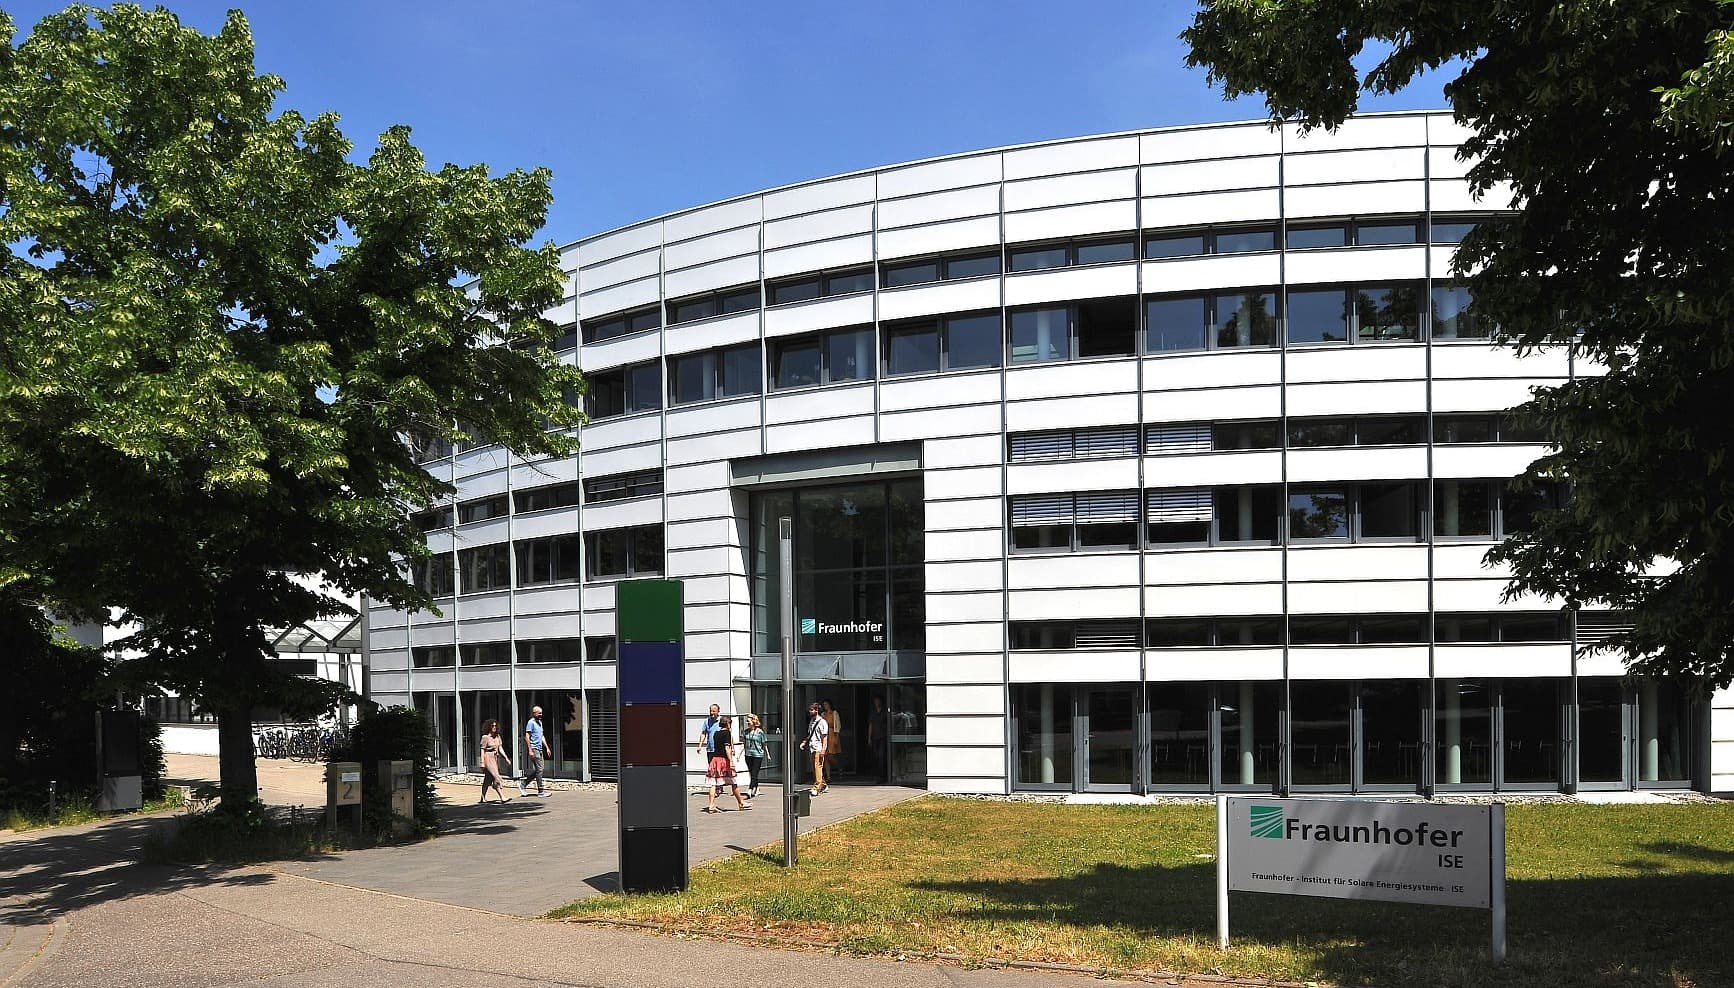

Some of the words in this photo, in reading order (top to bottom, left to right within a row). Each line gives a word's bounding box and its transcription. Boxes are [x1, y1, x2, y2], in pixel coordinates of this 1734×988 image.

[818, 621, 882, 634] Fraunhofer
[343, 782, 353, 800] 2
[1285, 818, 1464, 848] Fraunhofer
[1438, 854, 1464, 869] ISE
[1252, 873, 1294, 882] Fraunhofer
[1301, 875, 1331, 885] Institut
[1333, 877, 1346, 886] für
[1348, 878, 1374, 888] Solare
[1376, 880, 1444, 892] Energiesysteme
[1451, 885, 1464, 893] ISE
